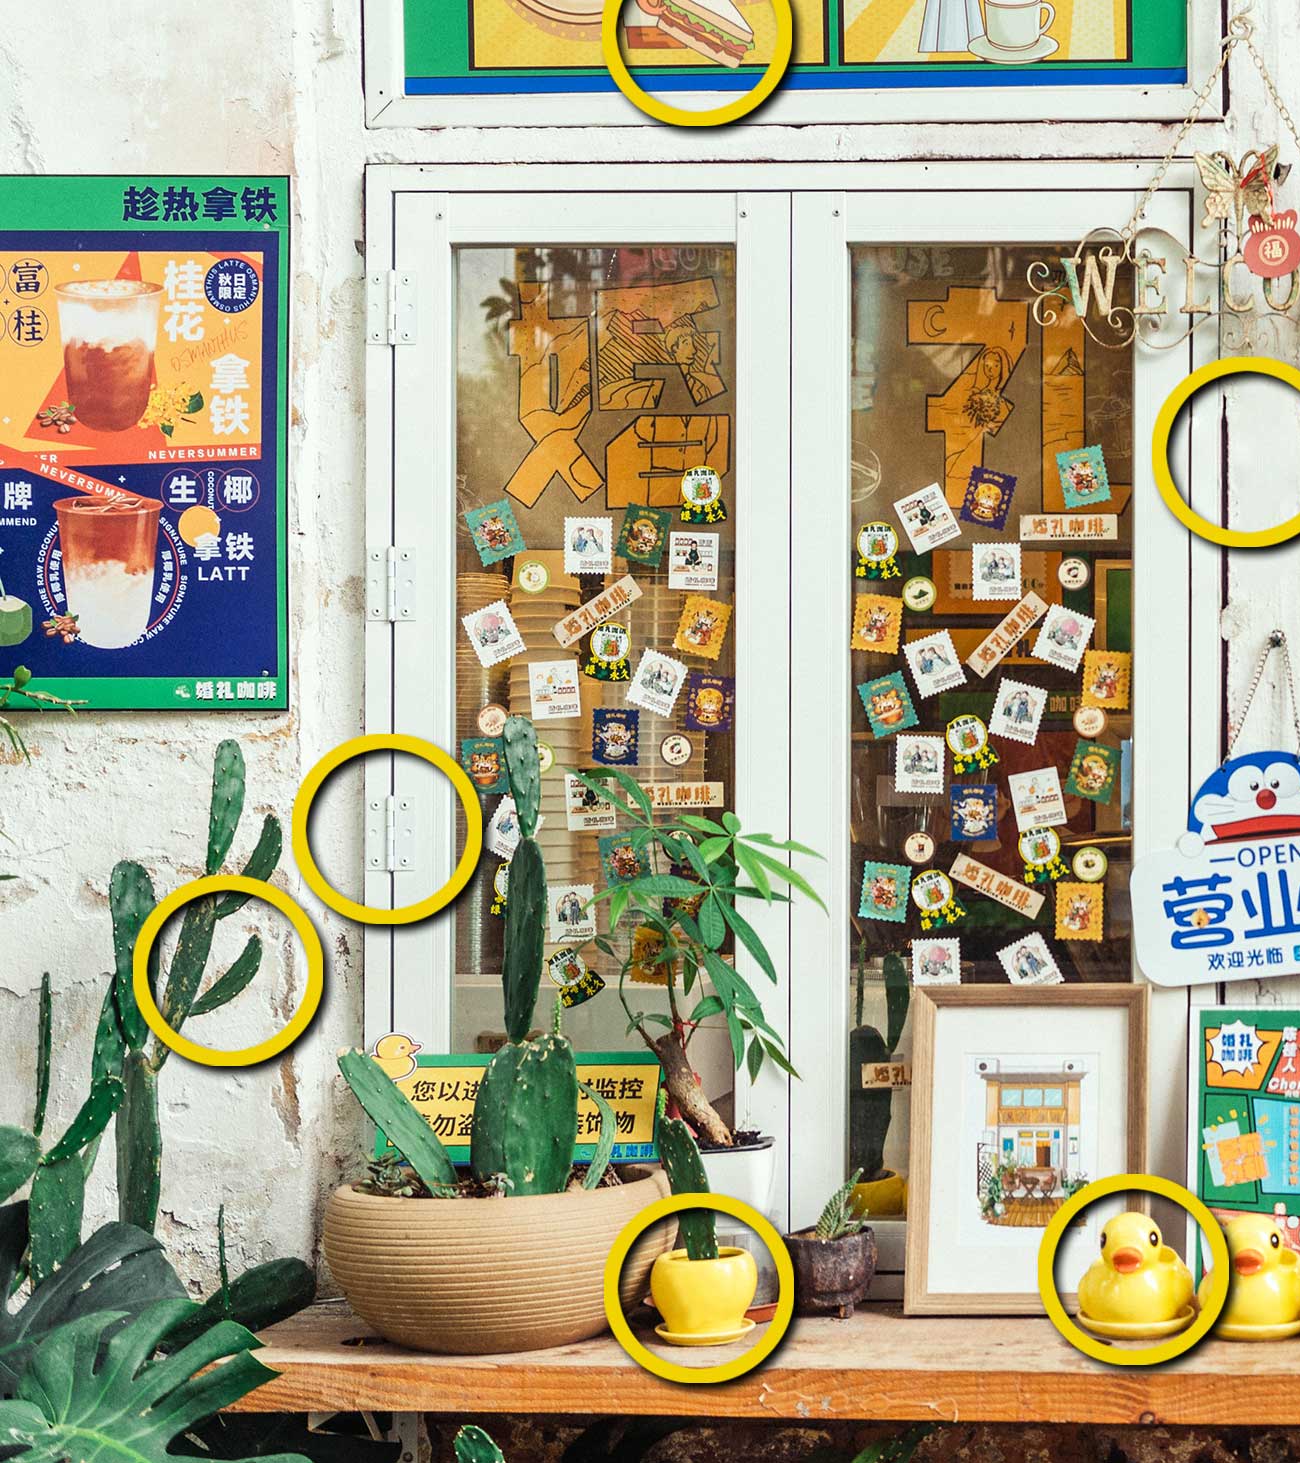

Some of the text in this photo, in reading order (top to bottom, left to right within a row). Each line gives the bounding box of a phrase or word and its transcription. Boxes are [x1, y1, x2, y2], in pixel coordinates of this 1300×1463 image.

[121, 186, 279, 223] 趁热拿铁
[1264, 241, 1285, 259] 福
[218, 259, 246, 270] LATTE
[218, 272, 247, 287] 秋日
[163, 259, 205, 343] 桂花
[218, 286, 247, 300] 限定
[209, 352, 251, 436] 拿铁
[148, 447, 258, 460] NEVERSUMMER
[207, 470, 215, 510] COCONUT
[159, 516, 189, 566] SIGNATURE
[193, 531, 255, 561] 拿铁
[197, 566, 251, 581] LATT
[195, 680, 278, 700] 婚礼咖啡
[1207, 947, 1284, 971] 欢迎光临
[1221, 1033, 1253, 1048] 婚礼
[1221, 1048, 1253, 1062] 咖啡
